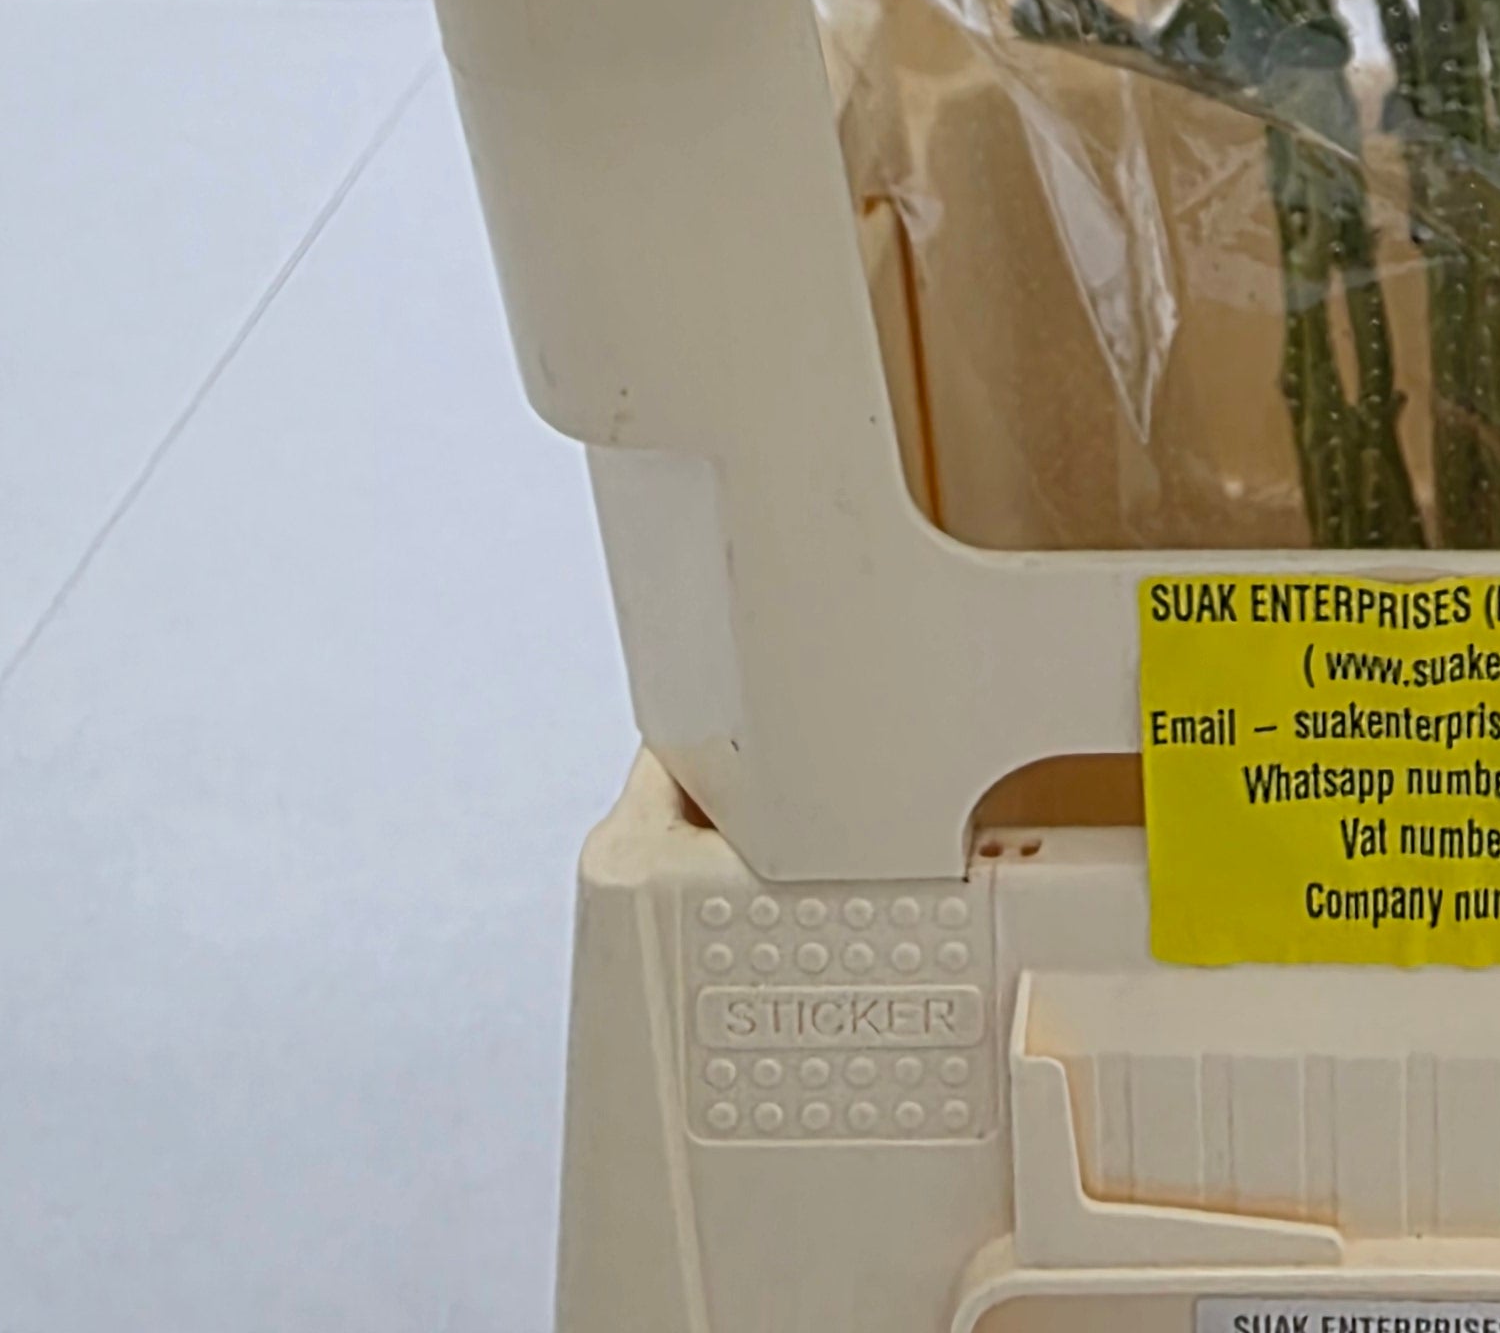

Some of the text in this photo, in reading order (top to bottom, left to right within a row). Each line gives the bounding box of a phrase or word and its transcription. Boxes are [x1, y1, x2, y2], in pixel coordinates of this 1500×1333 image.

[1150, 583, 1238, 624] SUAK
[1250, 583, 1472, 630] ENTERPRISES
[1150, 708, 1236, 746] Email
[1243, 762, 1394, 805] Whatsapp
[1340, 818, 1387, 860] Vat
[1305, 881, 1443, 929] Company
[726, 997, 956, 1036] STICKER
